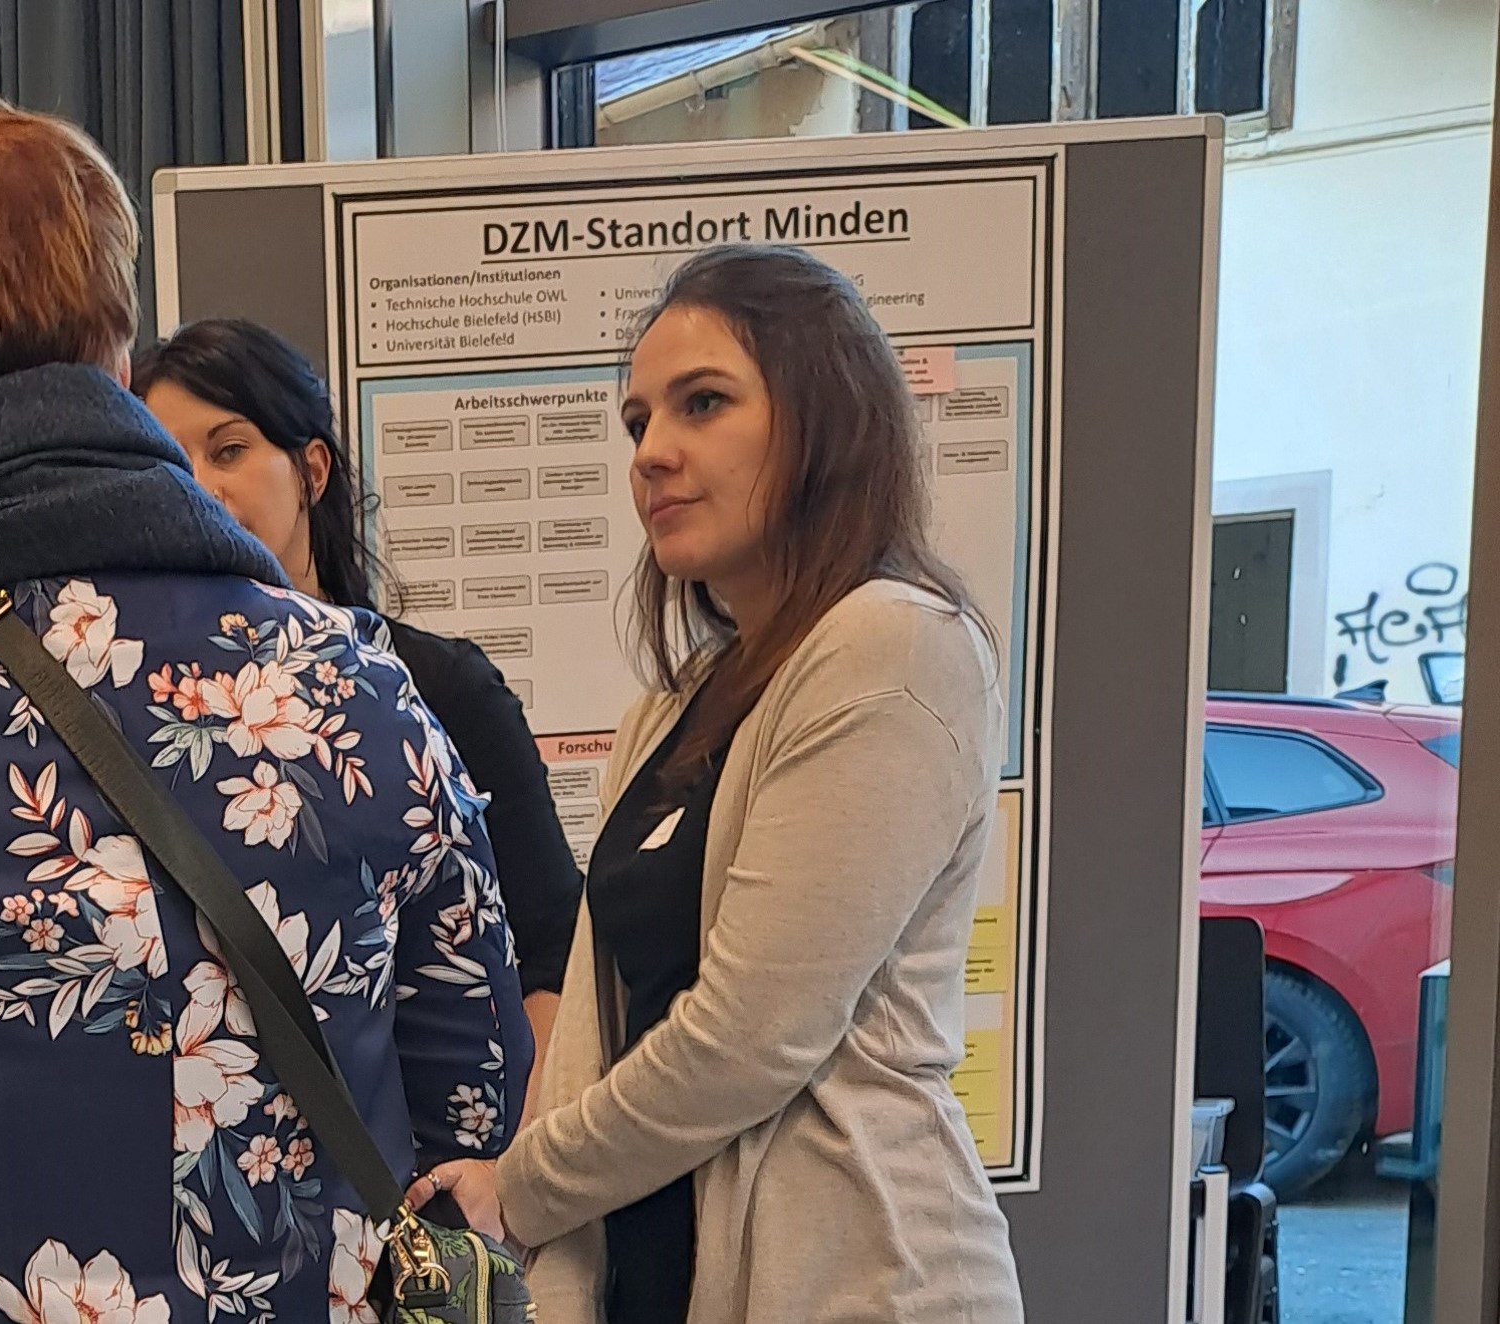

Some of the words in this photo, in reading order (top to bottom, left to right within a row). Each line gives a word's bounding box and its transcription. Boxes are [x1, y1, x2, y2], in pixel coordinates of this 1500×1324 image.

[483, 210, 751, 255] DZM-Standort
[764, 200, 909, 240] Minden
[369, 269, 561, 292] Organisationen/Institutionen
[385, 296, 456, 312] Technische
[459, 290, 533, 307] Hochschule
[536, 289, 568, 303] OWL
[614, 287, 663, 300] Univer
[865, 292, 925, 309] gineering
[385, 315, 460, 332] Hochschule
[463, 311, 519, 328] Bielefeld
[522, 308, 562, 327] (HSBI)
[386, 336, 456, 352] Universität
[459, 332, 515, 348] Bielefeld
[454, 389, 608, 411] Arbeitsschwerpunkte
[558, 739, 613, 756] Forschu
